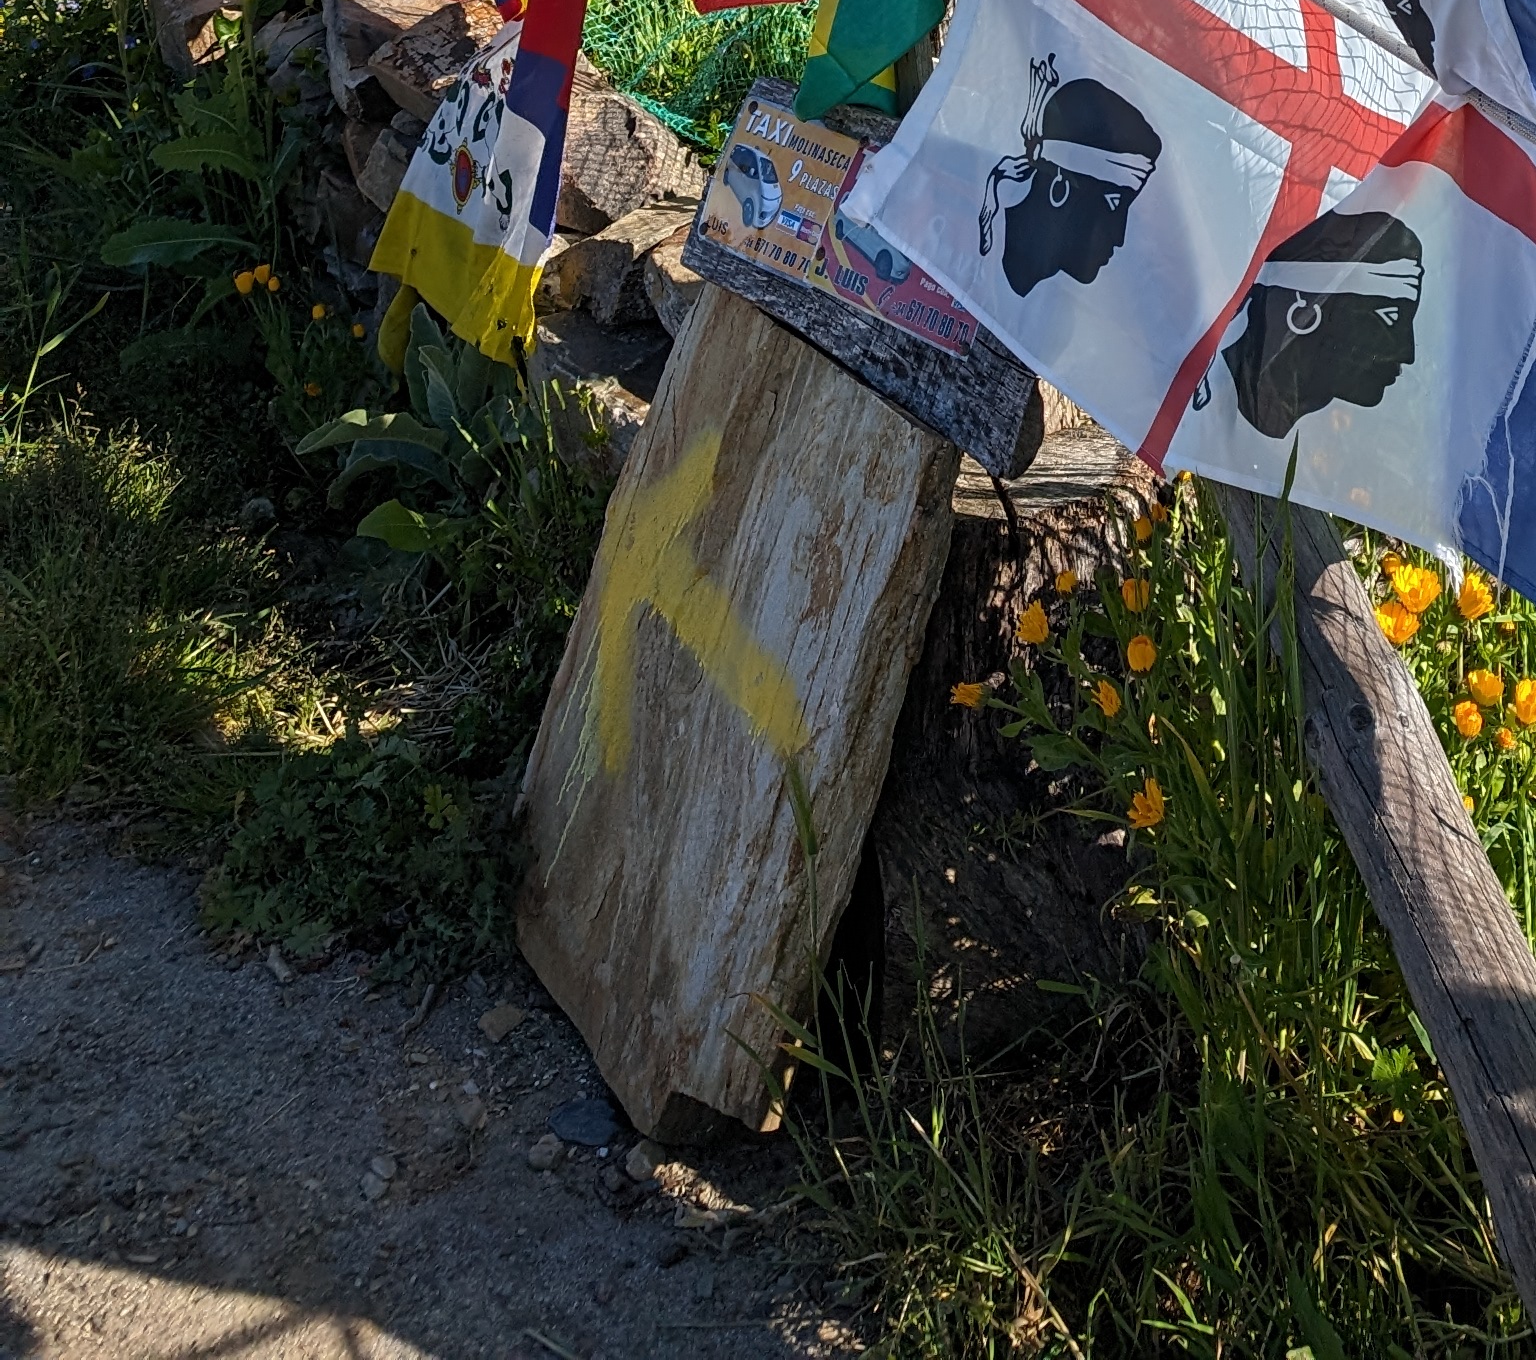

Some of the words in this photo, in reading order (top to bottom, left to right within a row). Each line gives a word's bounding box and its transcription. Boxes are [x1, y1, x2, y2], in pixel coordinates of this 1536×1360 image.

[745, 109, 795, 147] TAXI
[788, 135, 851, 172] MOLINASECA
[787, 158, 804, 183] 9
[799, 172, 840, 201] PLAZAS
[780, 216, 796, 229] VISA
[753, 237, 770, 256] 671
[768, 243, 782, 261] 70
[782, 250, 797, 268] 80
[834, 265, 869, 296] LUIS
[905, 298, 926, 327] 671
[921, 306, 940, 333] 70
[937, 312, 956, 340] 80
